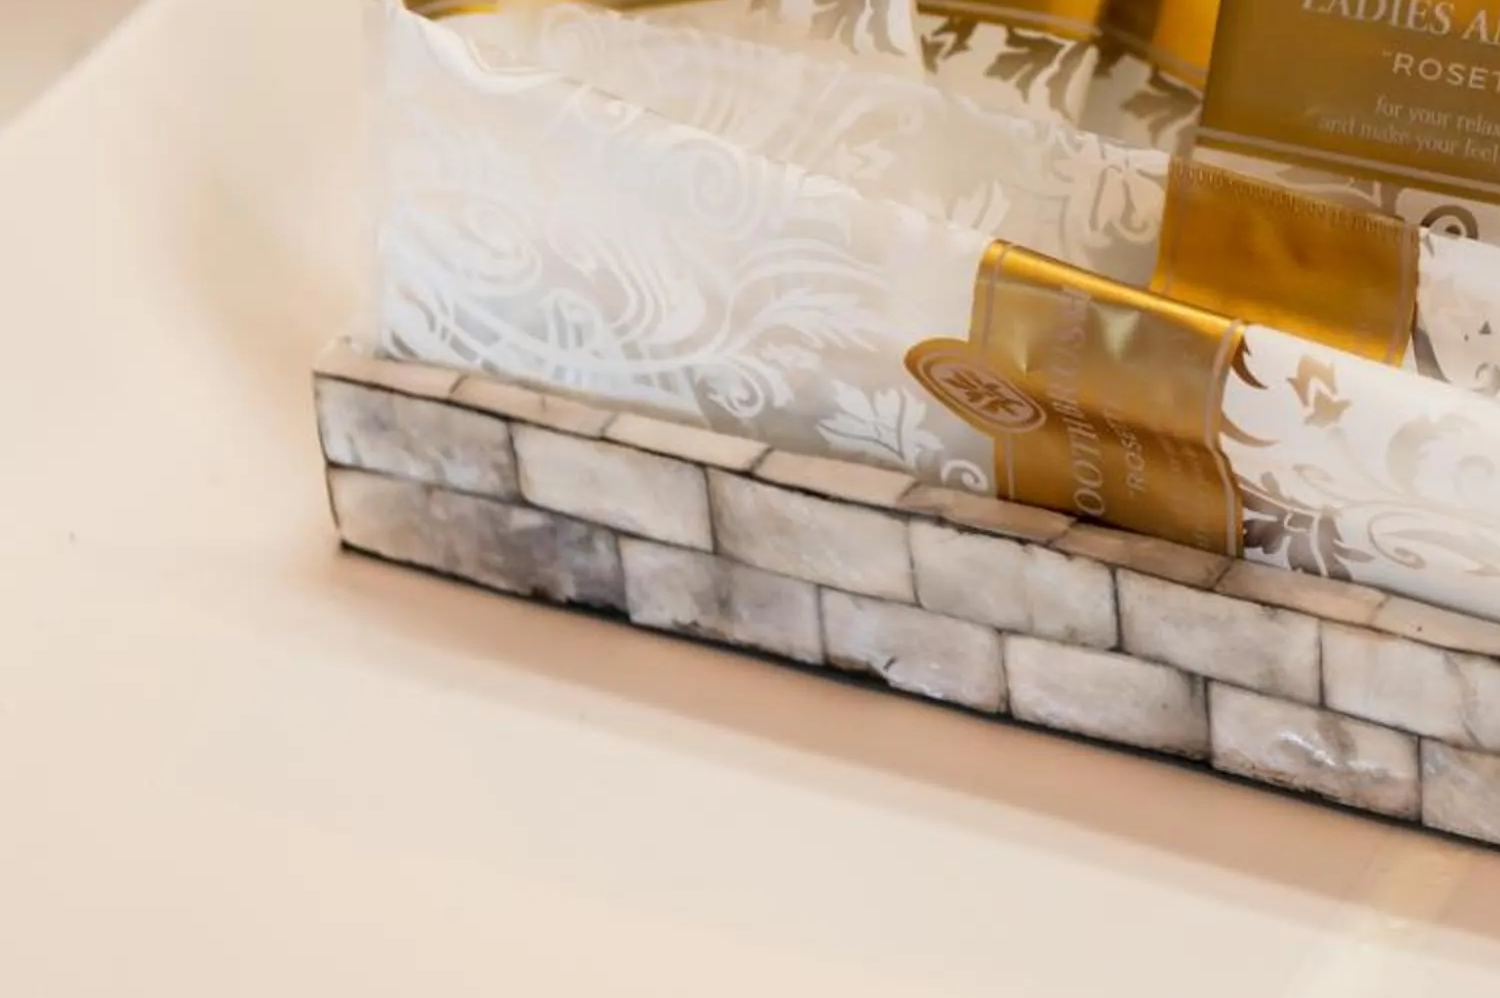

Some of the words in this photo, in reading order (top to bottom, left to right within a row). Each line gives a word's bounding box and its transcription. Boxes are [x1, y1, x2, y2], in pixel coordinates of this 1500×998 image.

[1375, 94, 1402, 120] for
[1408, 106, 1452, 130] your
[1317, 114, 1357, 138] and
[1357, 118, 1410, 147] make
[1414, 131, 1462, 158] your
[1465, 136, 1500, 165] feel
